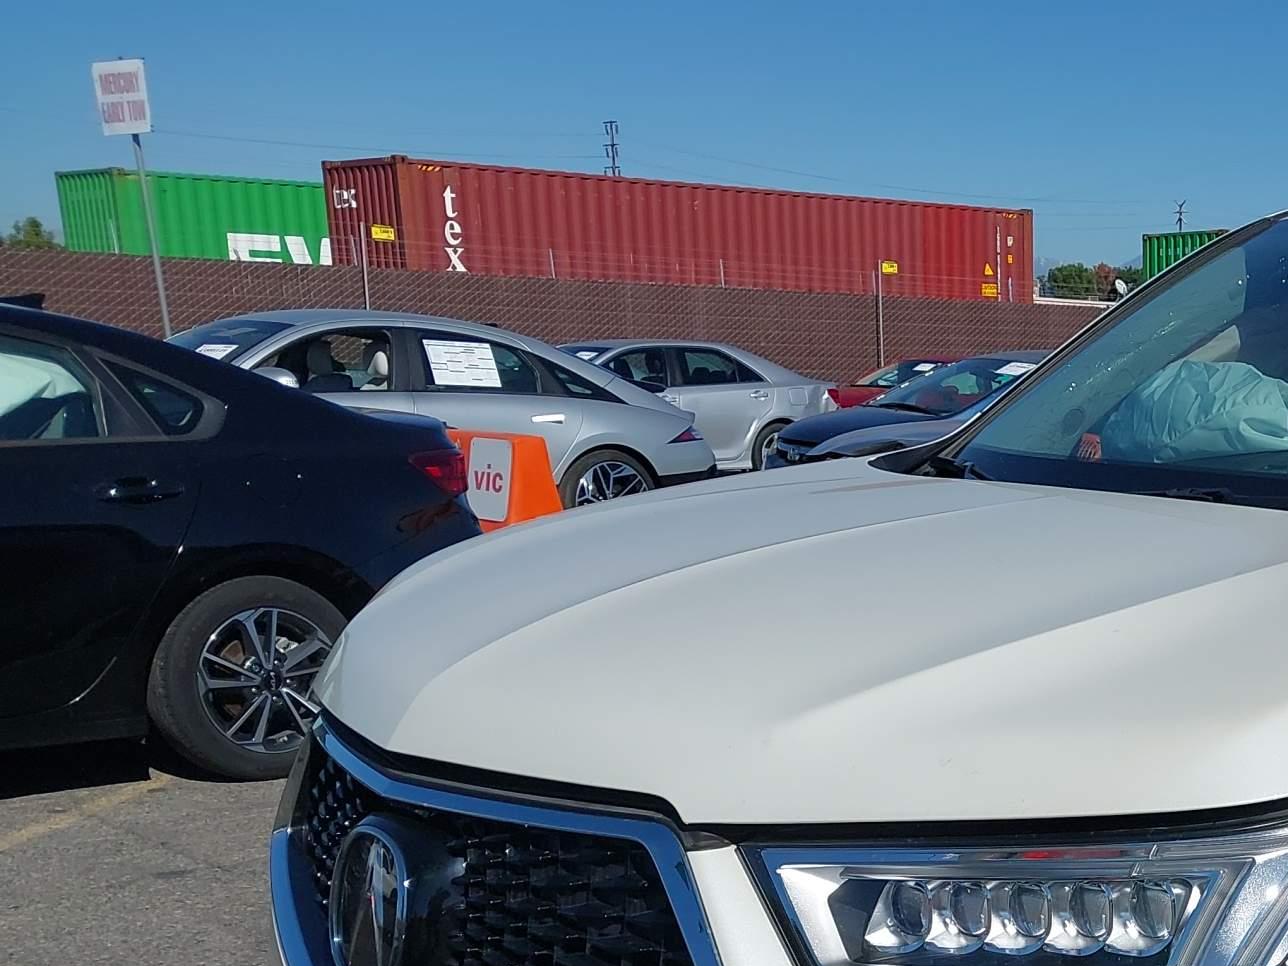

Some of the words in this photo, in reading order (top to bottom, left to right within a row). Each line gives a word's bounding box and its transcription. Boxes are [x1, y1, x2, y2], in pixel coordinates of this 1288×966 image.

[99, 72, 139, 96] MERCURY
[101, 101, 125, 123] EARLY
[126, 99, 146, 121] TOW
[442, 184, 468, 272] tex
[474, 464, 504, 494] vic
